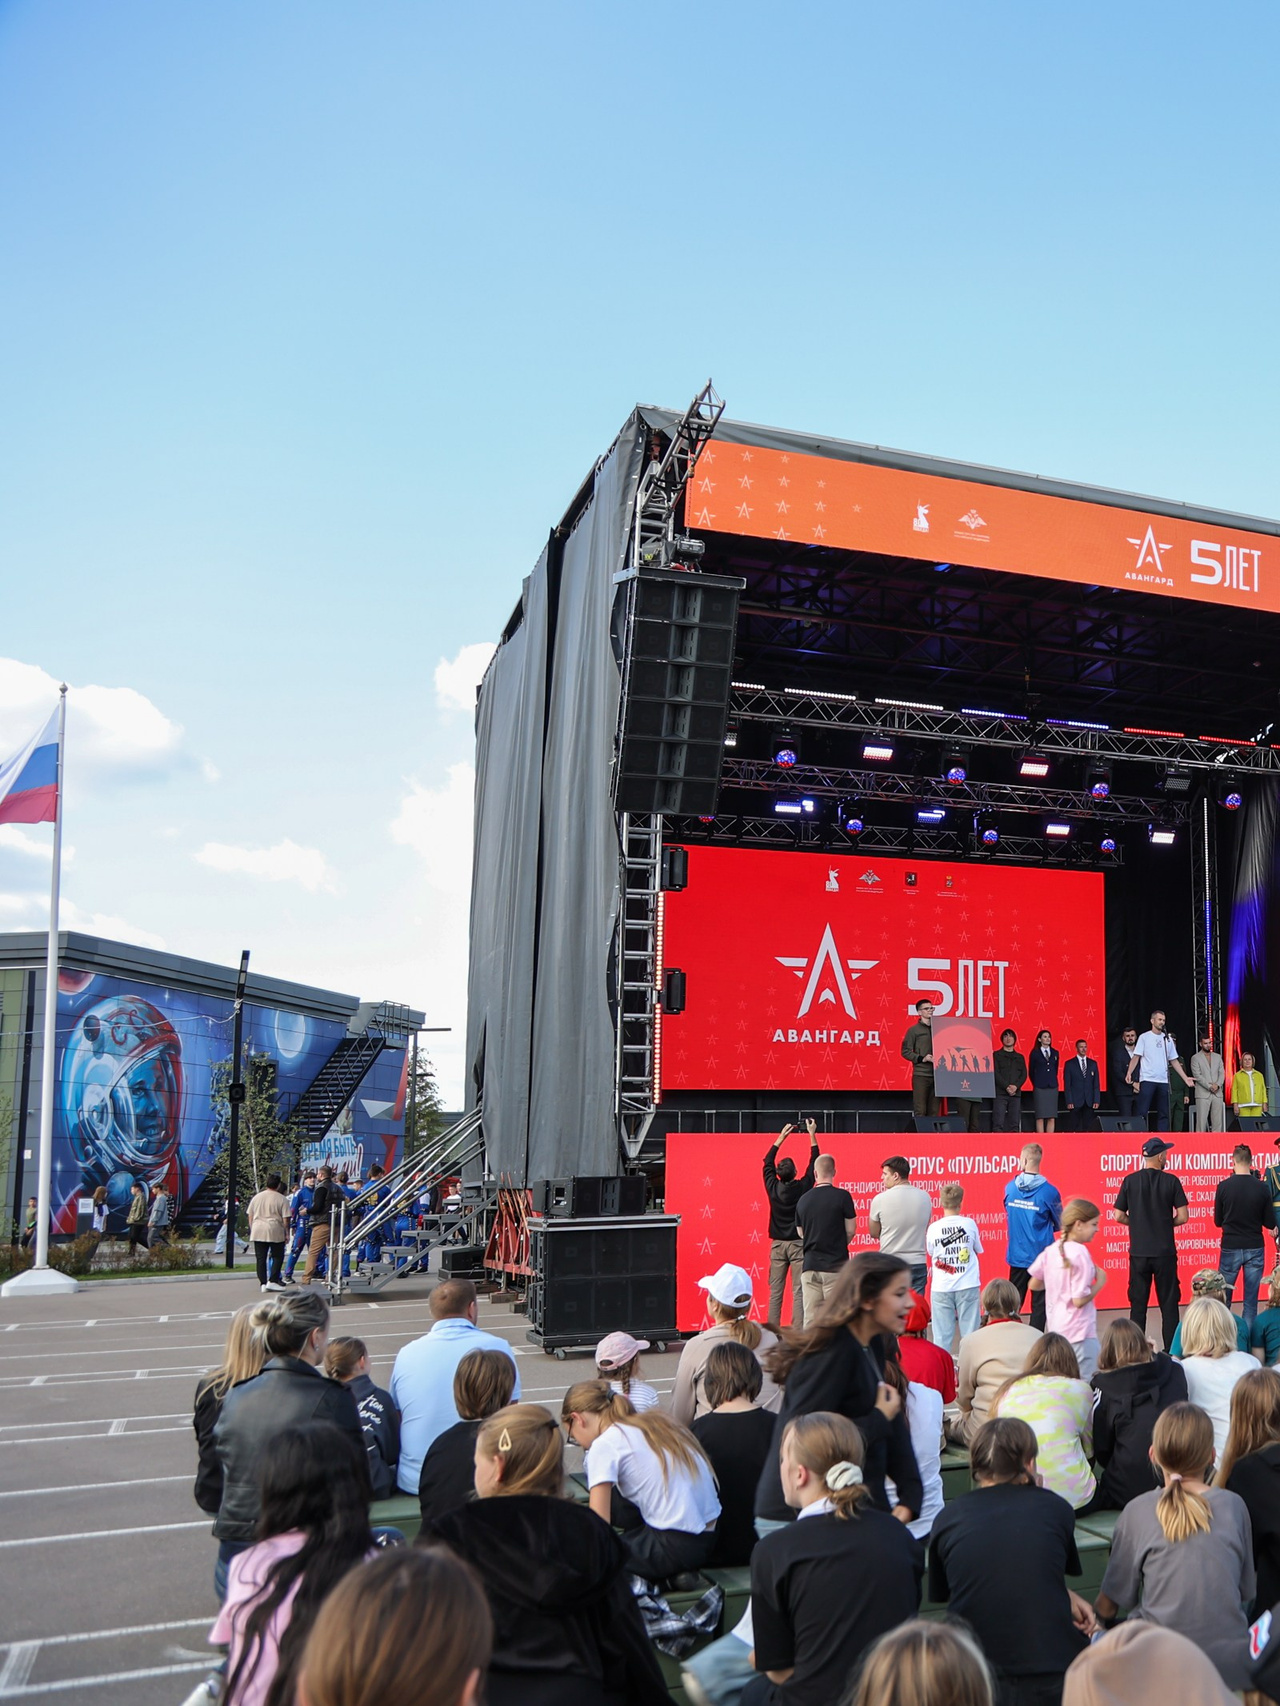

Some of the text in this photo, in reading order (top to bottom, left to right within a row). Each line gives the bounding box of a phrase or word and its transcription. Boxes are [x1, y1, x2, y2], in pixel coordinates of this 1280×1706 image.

[1190, 539, 1262, 592] 5 ЛЕТ
[1124, 571, 1174, 587] АВАНГАРД
[907, 957, 1009, 1018] 5 ЛЕТ
[772, 1028, 881, 1046] АВАНГАРД
[904, 1156, 944, 1175] РПУС
[1185, 1152, 1234, 1171] КОМПЛЕ
